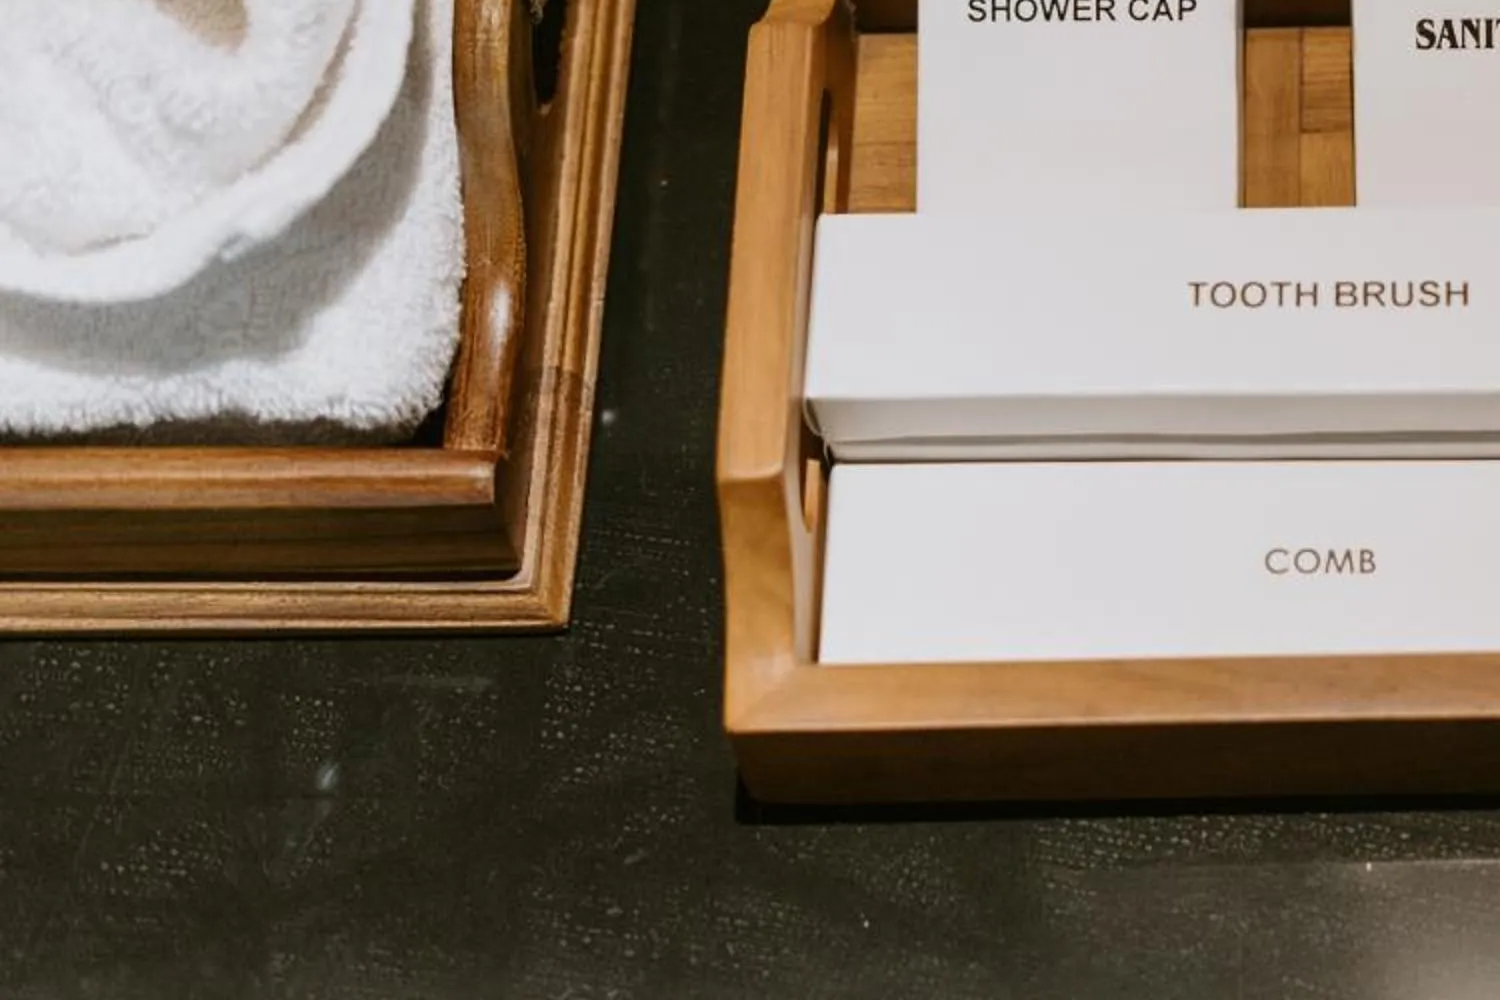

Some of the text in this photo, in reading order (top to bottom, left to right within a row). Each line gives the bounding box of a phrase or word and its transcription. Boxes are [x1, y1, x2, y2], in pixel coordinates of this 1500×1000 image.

[1187, 279, 1469, 309] TOOTH BRUSH
[1264, 548, 1377, 575] COMB
